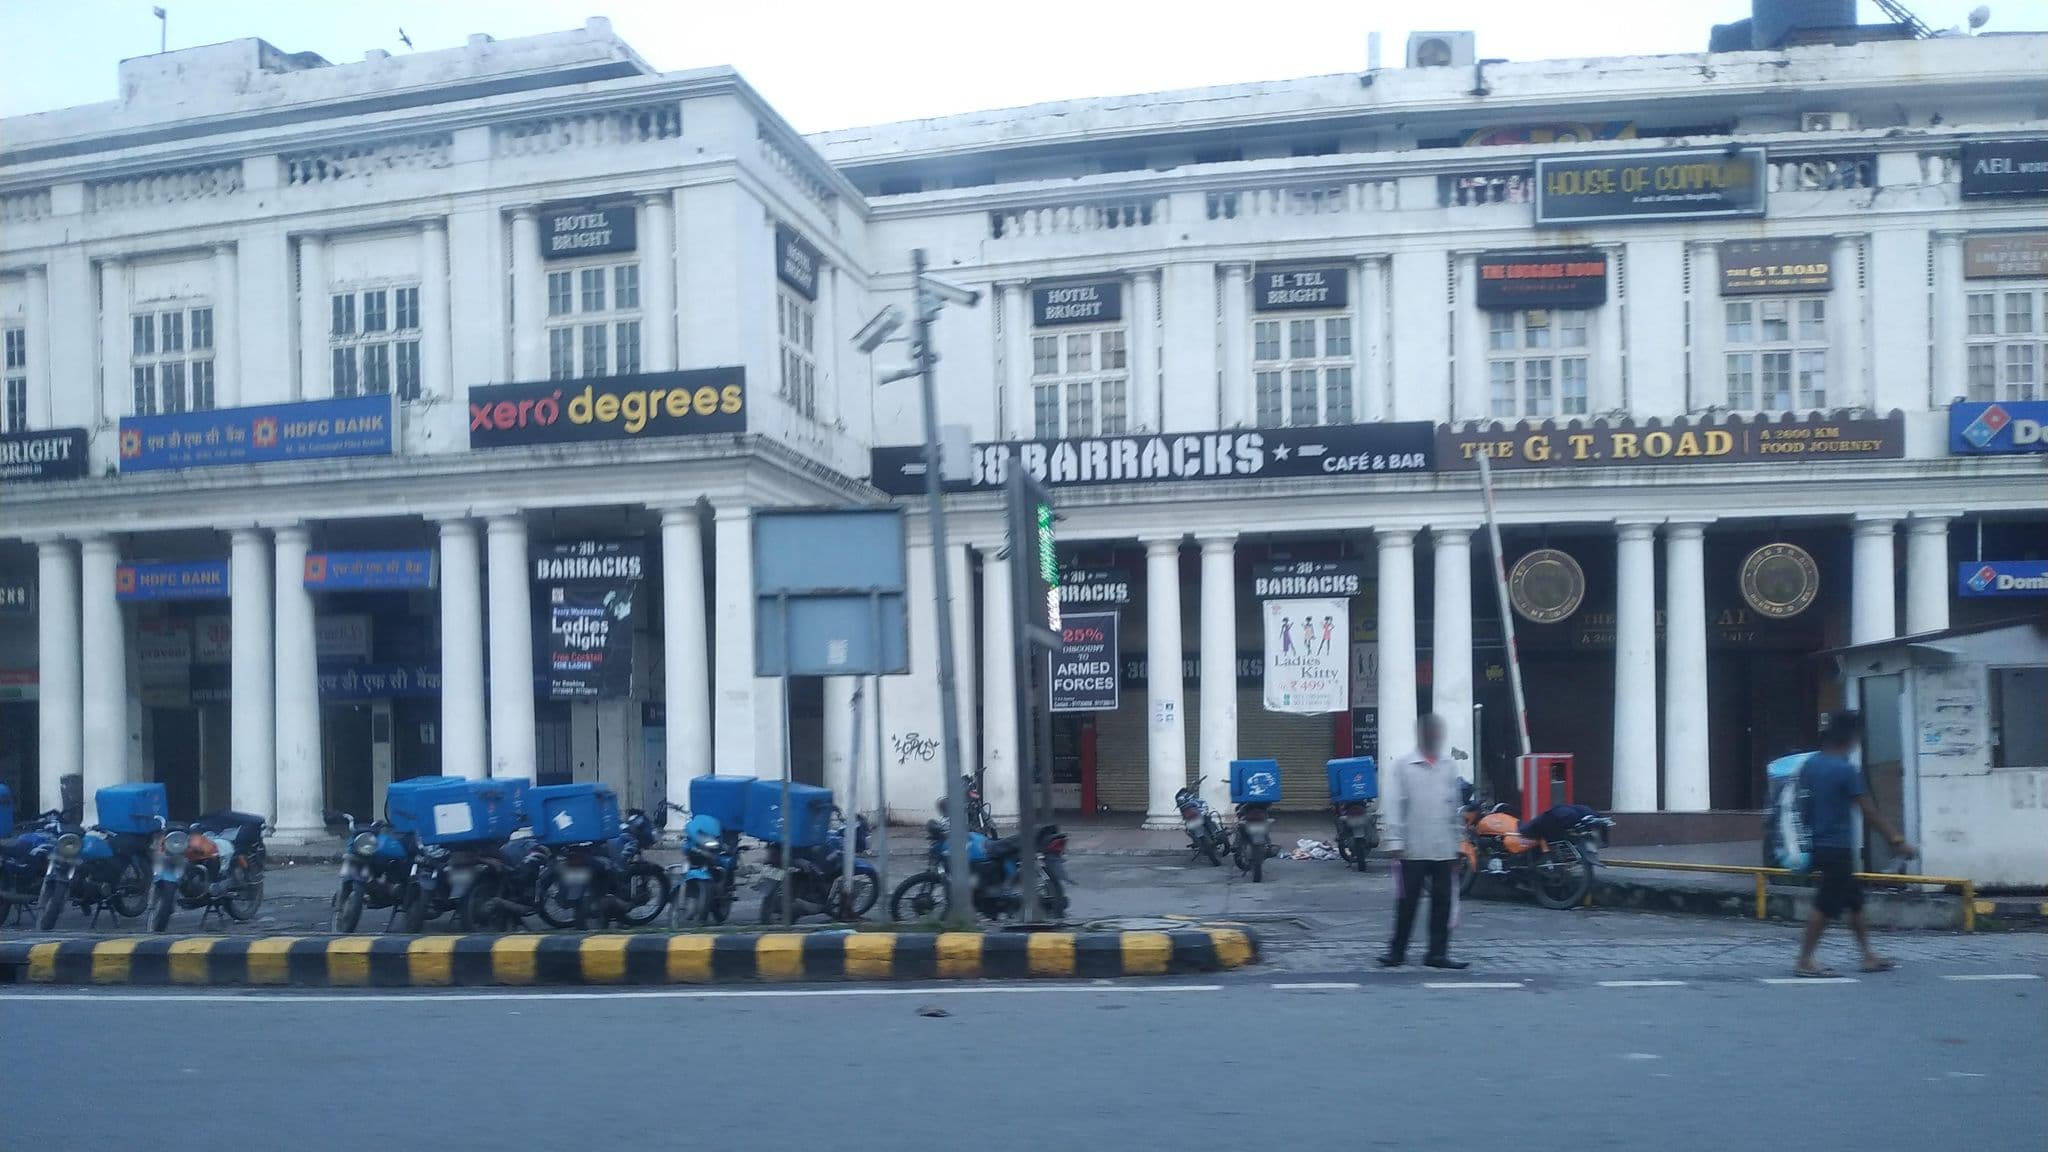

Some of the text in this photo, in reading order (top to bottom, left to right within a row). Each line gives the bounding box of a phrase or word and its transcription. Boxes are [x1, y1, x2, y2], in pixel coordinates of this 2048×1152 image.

[1548, 168, 1616, 195] HOUSE
[1621, 167, 1649, 192] OF
[554, 213, 608, 232] HOTEL
[552, 230, 612, 250] BRIGHT
[1782, 264, 1828, 275] ROAD
[1048, 287, 1099, 304] HOTEL
[1267, 287, 1328, 304] BRIGHT
[1045, 302, 1102, 320] BRIGHT
[568, 384, 742, 434] degrees
[284, 415, 384, 438] HDFC BANK
[1760, 429, 1771, 440] A
[1814, 427, 1840, 438] KM
[1461, 441, 1514, 460] THE
[1611, 430, 1733, 459] ROAD
[1760, 440, 1883, 454] FOOD JOURNEY
[1020, 433, 1265, 483] BARRACKS
[1322, 451, 1370, 473] CAFÉ
[1371, 456, 1385, 470] &
[1389, 452, 1426, 469] BAR
[537, 556, 641, 580] BARRACKS
[140, 570, 221, 587] HDFC BANK
[1255, 575, 1359, 595] BARRACKS
[552, 615, 609, 634] Ladies
[564, 633, 607, 650] Night
[1062, 626, 1104, 643] 25%
[1062, 644, 1104, 654] DISCOUNT
[1057, 661, 1110, 676] ARMED
[1274, 655, 1321, 667] Ladies
[1301, 666, 1339, 680] Kitty
[1054, 677, 1114, 692] FORCES
